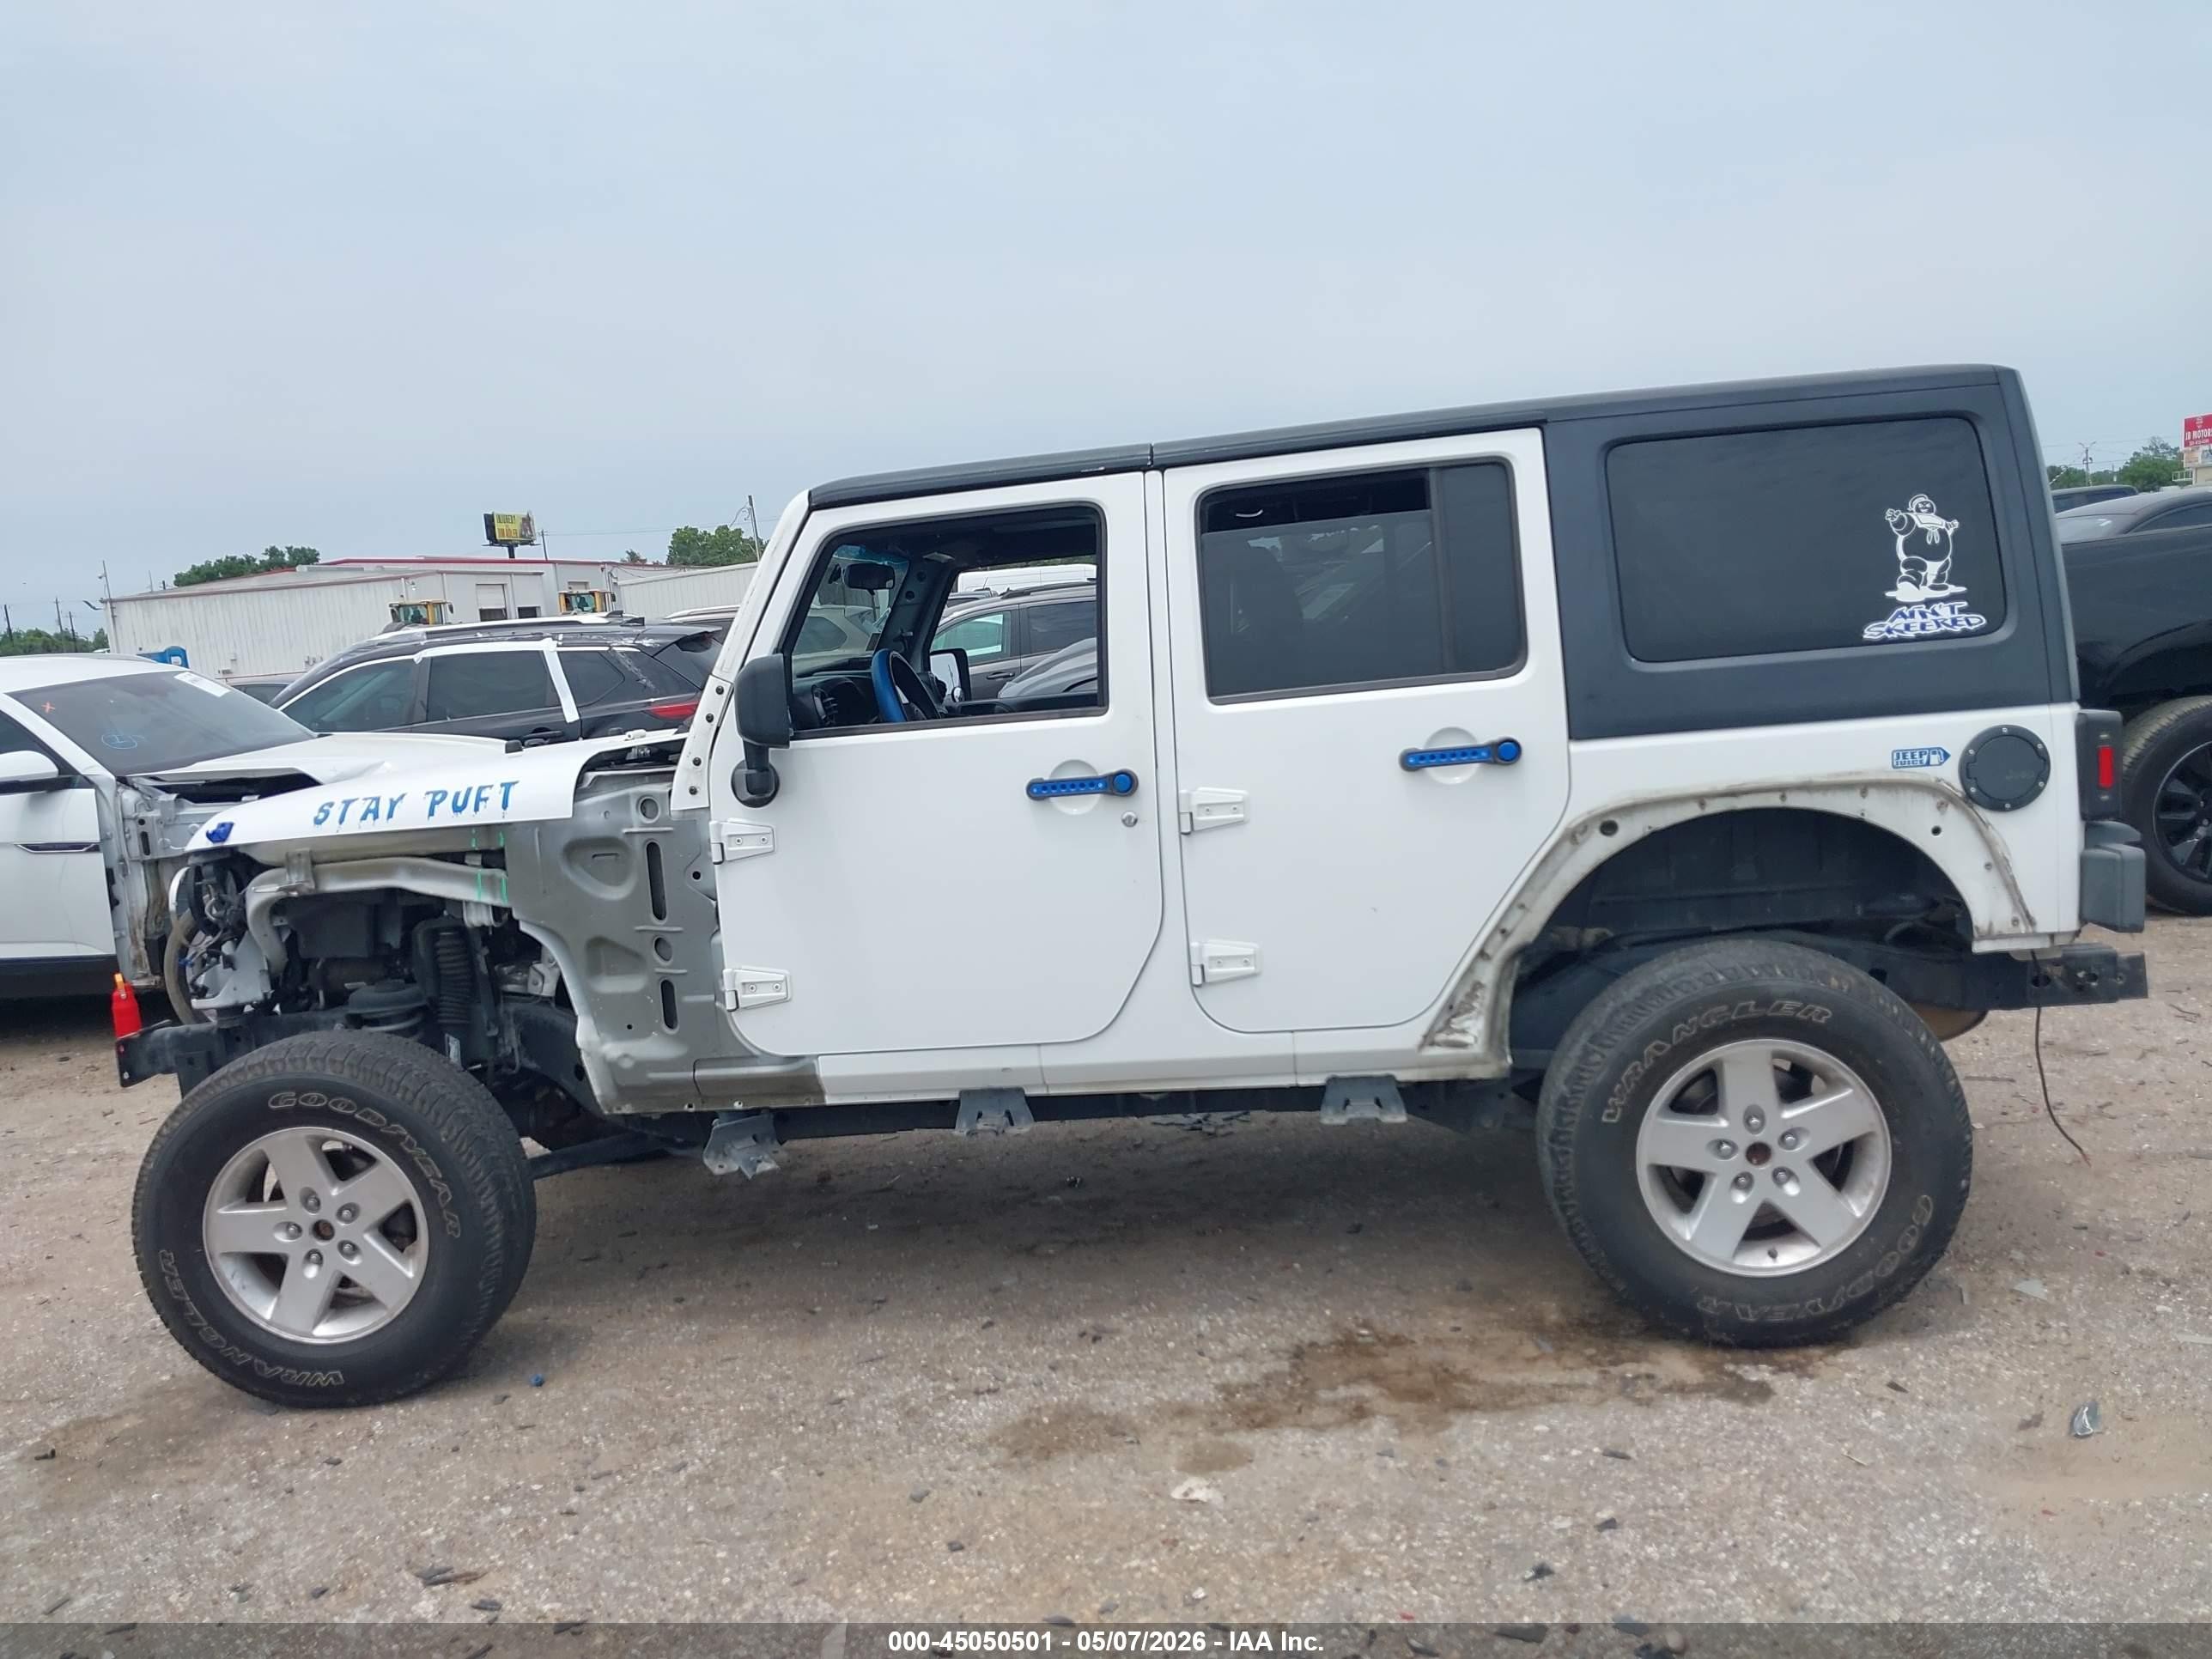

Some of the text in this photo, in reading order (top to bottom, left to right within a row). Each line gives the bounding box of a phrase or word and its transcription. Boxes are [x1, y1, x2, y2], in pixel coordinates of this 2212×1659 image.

[1863, 614, 1986, 638] SKEERED
[1888, 602, 1967, 621] AIN'T
[1895, 750, 1928, 761] JEEP
[313, 781, 519, 831] STAY PUFT
[1601, 1000, 1832, 1122] WRANGLER
[268, 1092, 461, 1237] GOODYEAR
[1697, 1194, 1932, 1322] GOODYEAR
[159, 1249, 345, 1386] WRANGLER
